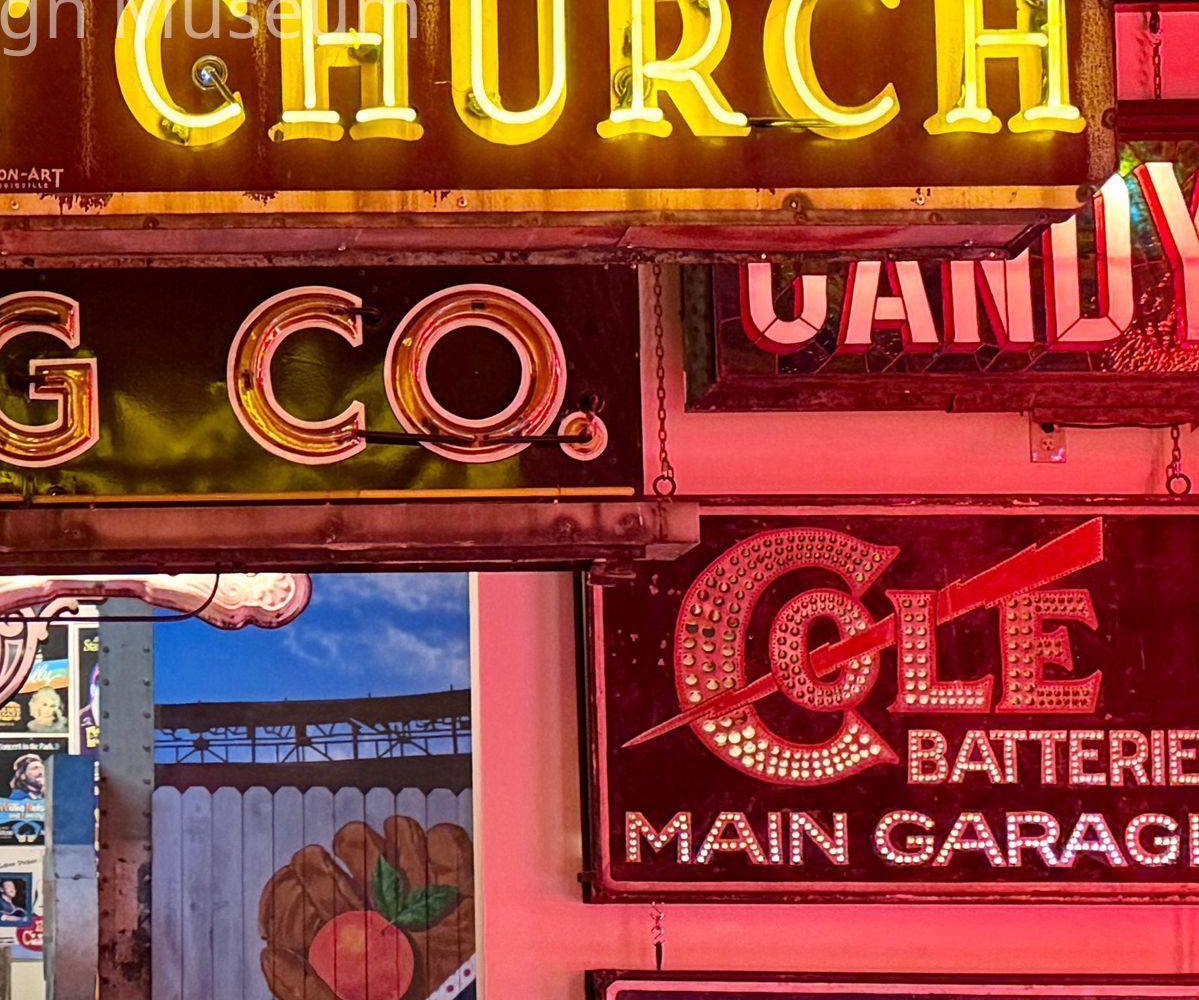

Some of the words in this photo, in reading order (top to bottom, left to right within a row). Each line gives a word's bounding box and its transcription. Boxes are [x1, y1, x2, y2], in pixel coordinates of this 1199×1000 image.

[227, 284, 608, 465] CO.
[625, 811, 850, 867] MAIN
[874, 811, 1199, 868] GARAG
